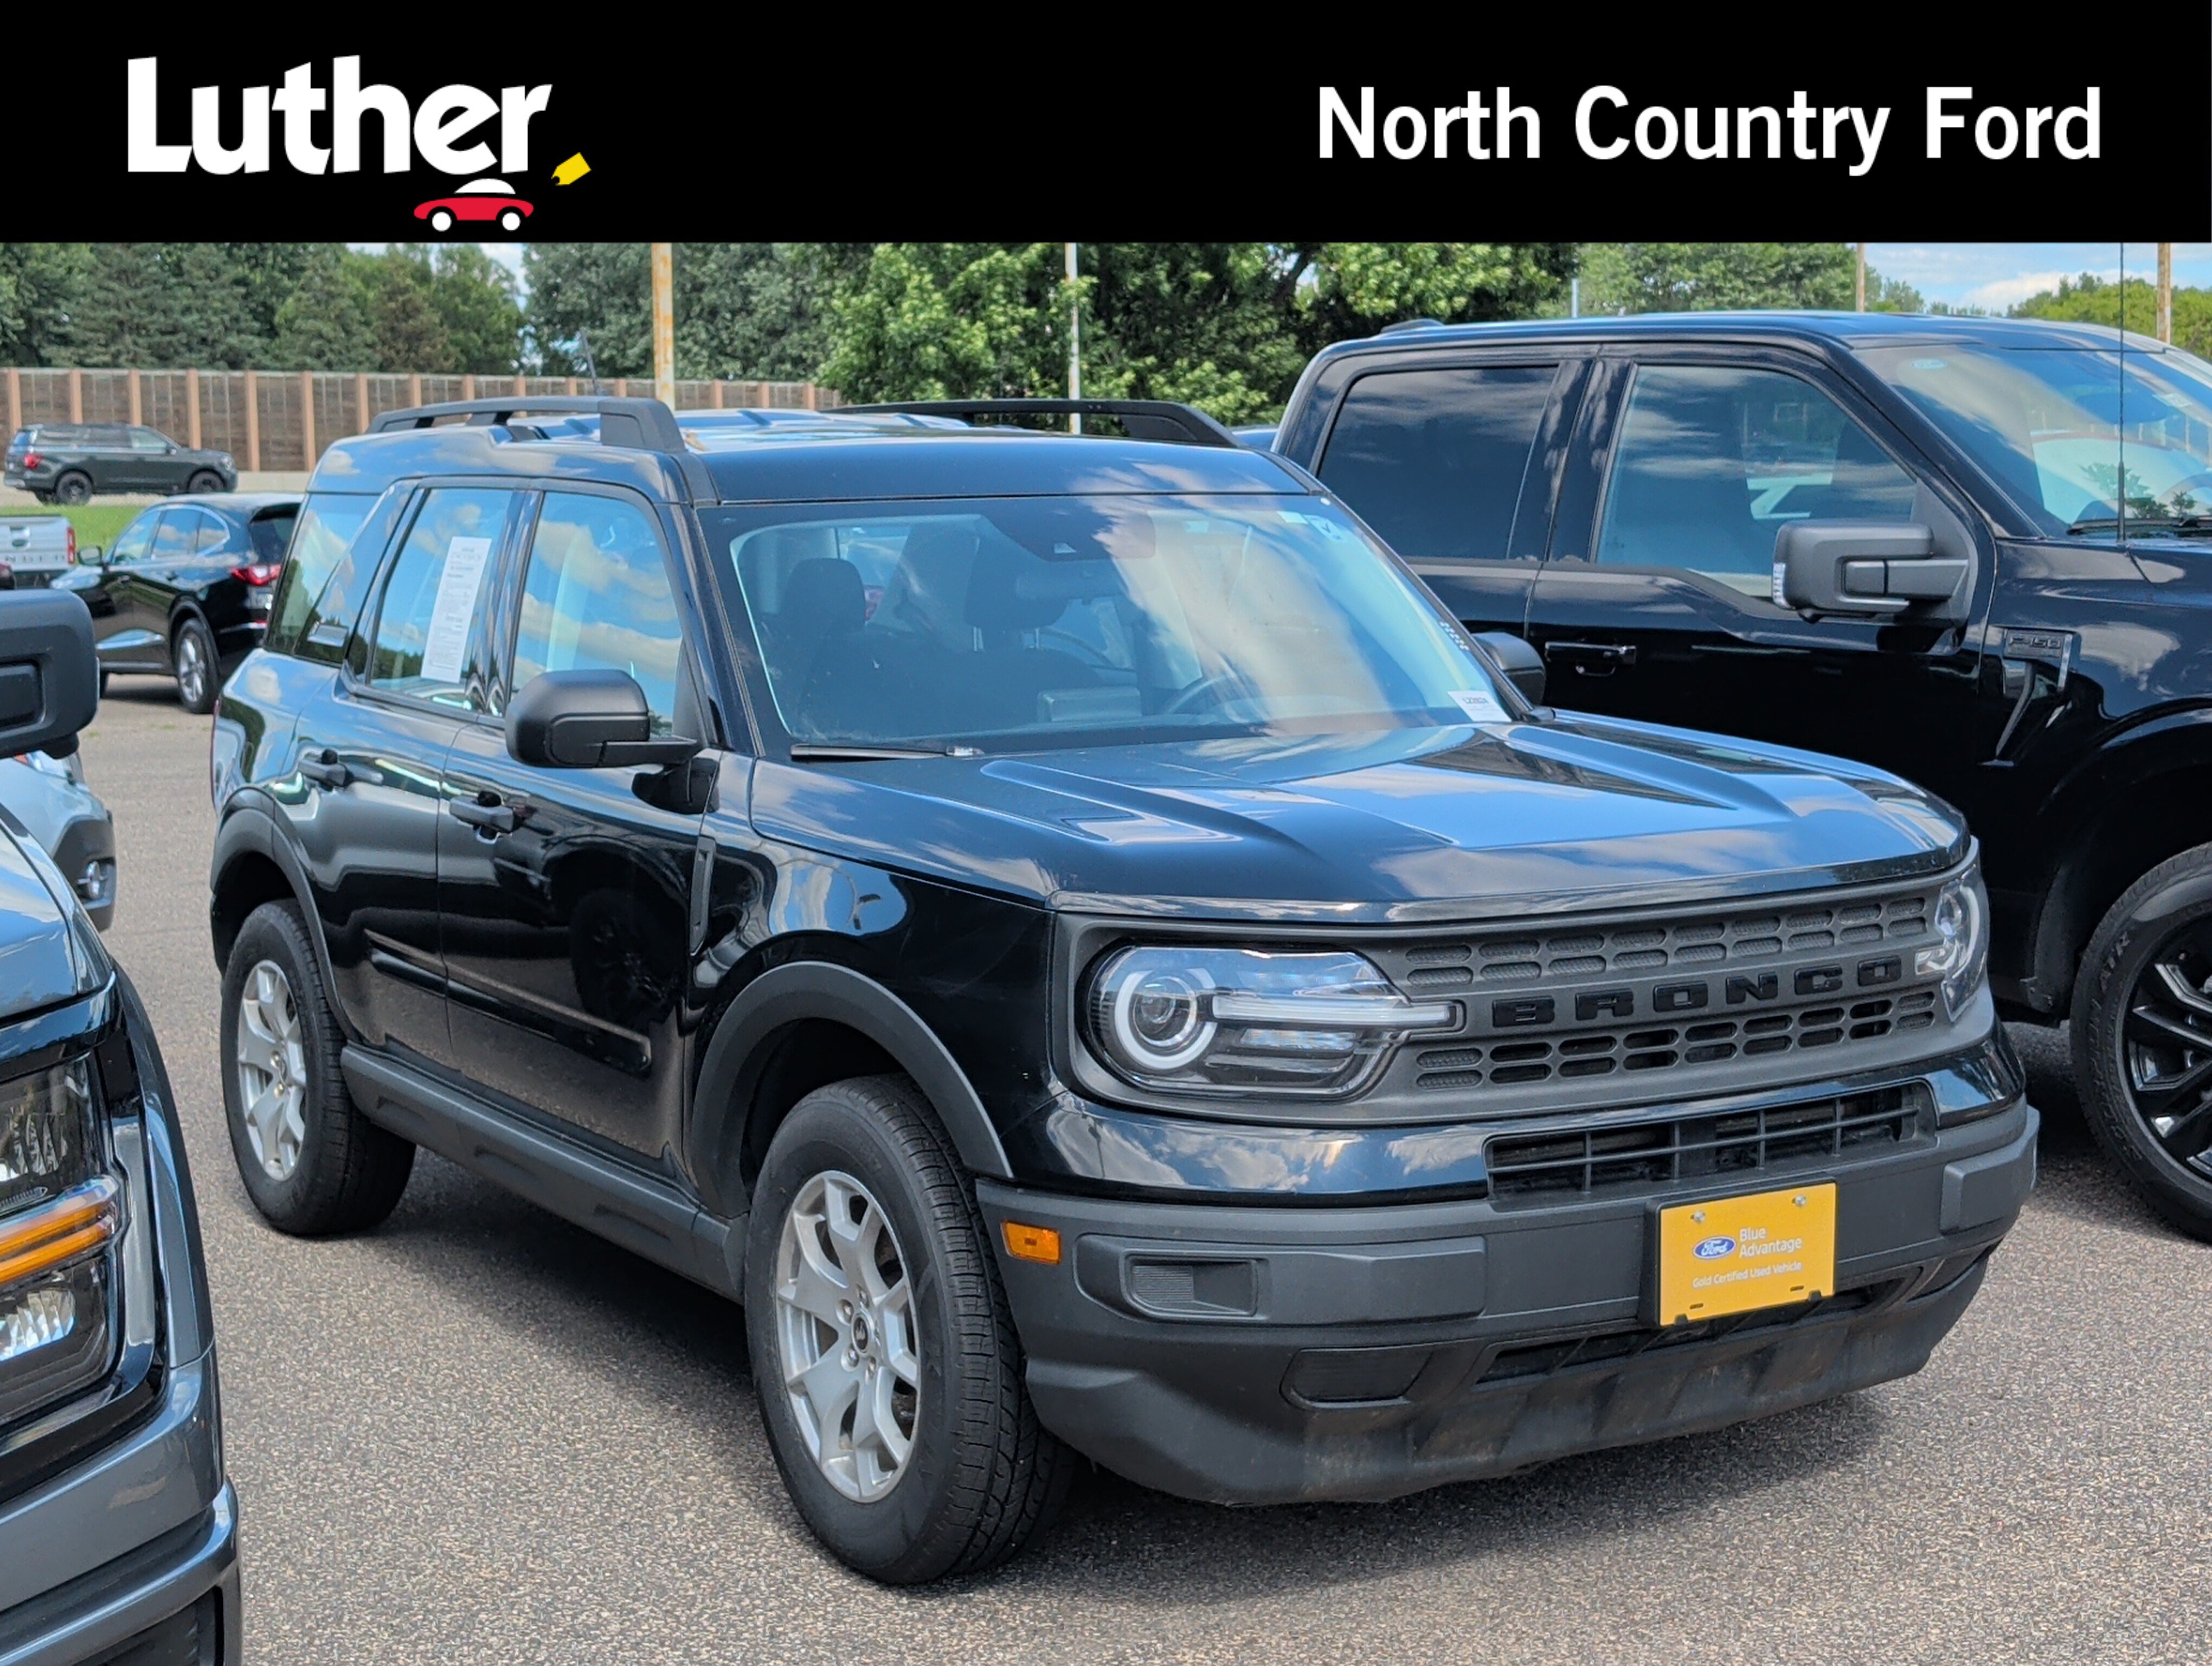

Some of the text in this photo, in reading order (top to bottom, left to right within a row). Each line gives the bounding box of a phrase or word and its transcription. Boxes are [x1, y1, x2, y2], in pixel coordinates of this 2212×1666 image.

[1492, 956, 1901, 1028] BRONCO
[1740, 1228, 1766, 1241] Blue
[1740, 1238, 1802, 1257] Advantage
[1692, 1261, 1803, 1288] Gold Certified Used Vehicle
